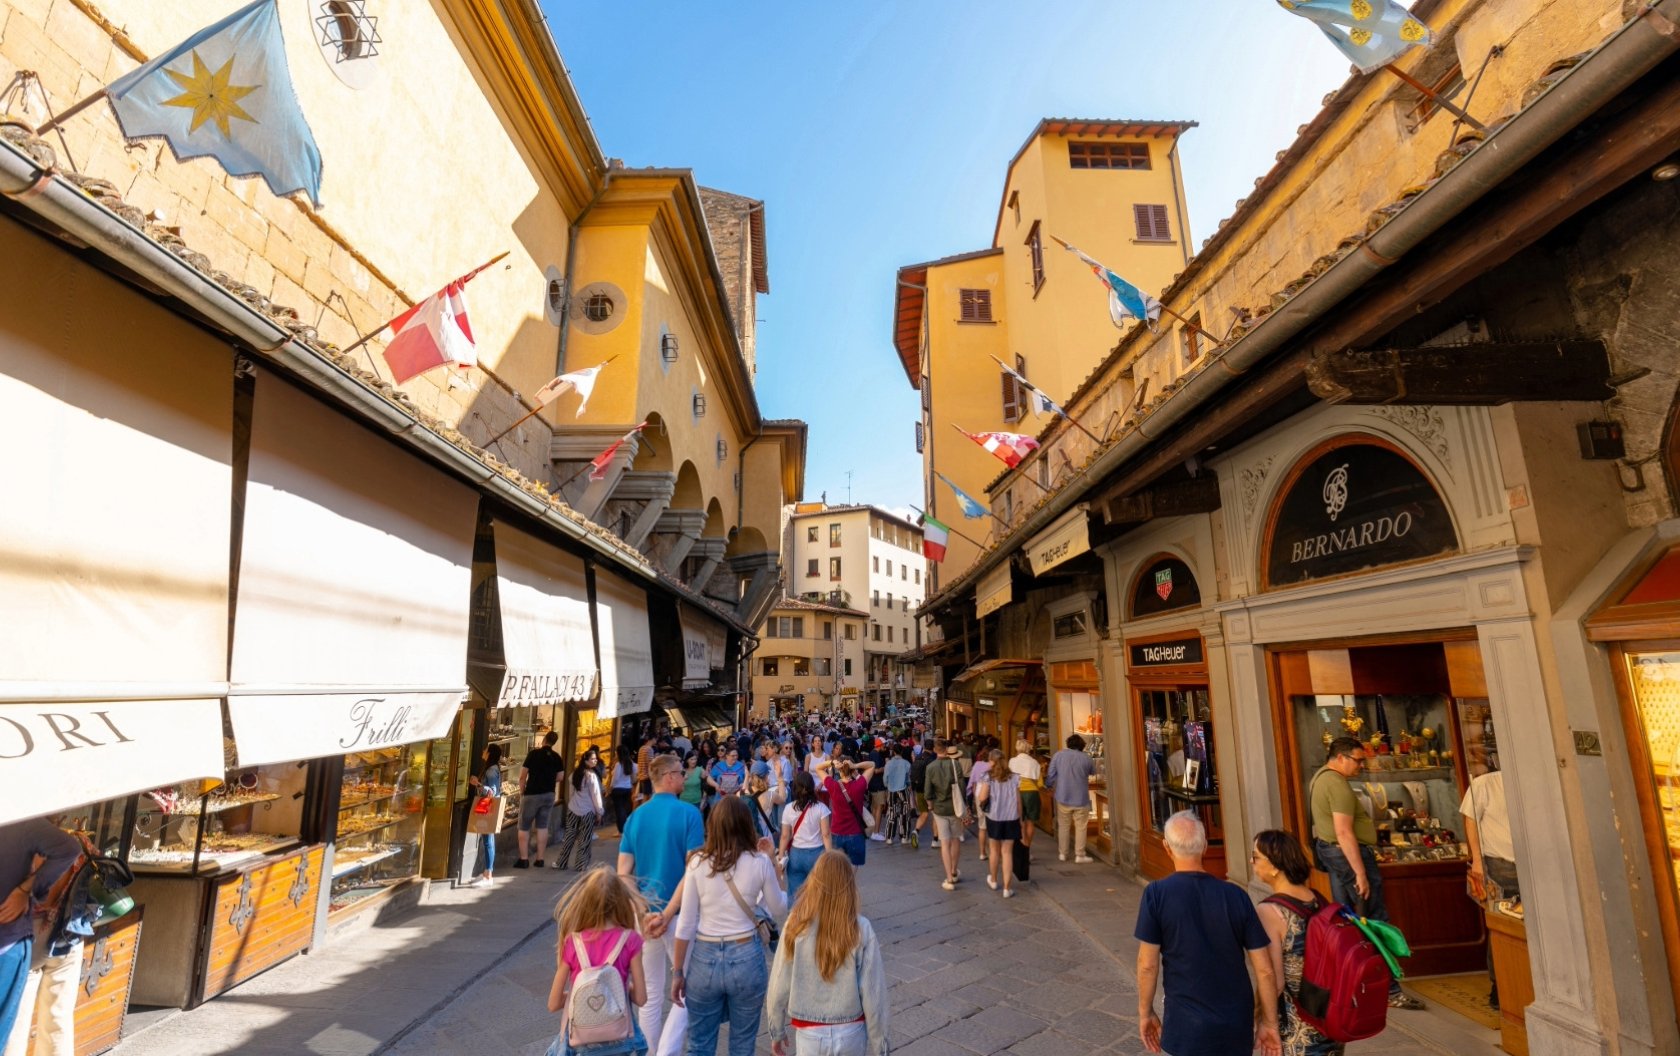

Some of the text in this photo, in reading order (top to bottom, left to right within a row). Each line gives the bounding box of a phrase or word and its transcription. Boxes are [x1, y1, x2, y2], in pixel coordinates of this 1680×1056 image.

[1290, 511, 1412, 564] BERNARDO
[1157, 570, 1171, 583] TAG
[686, 639, 706, 660] U-BOAT
[571, 674, 585, 696] 43
[339, 698, 411, 749] Frilli
